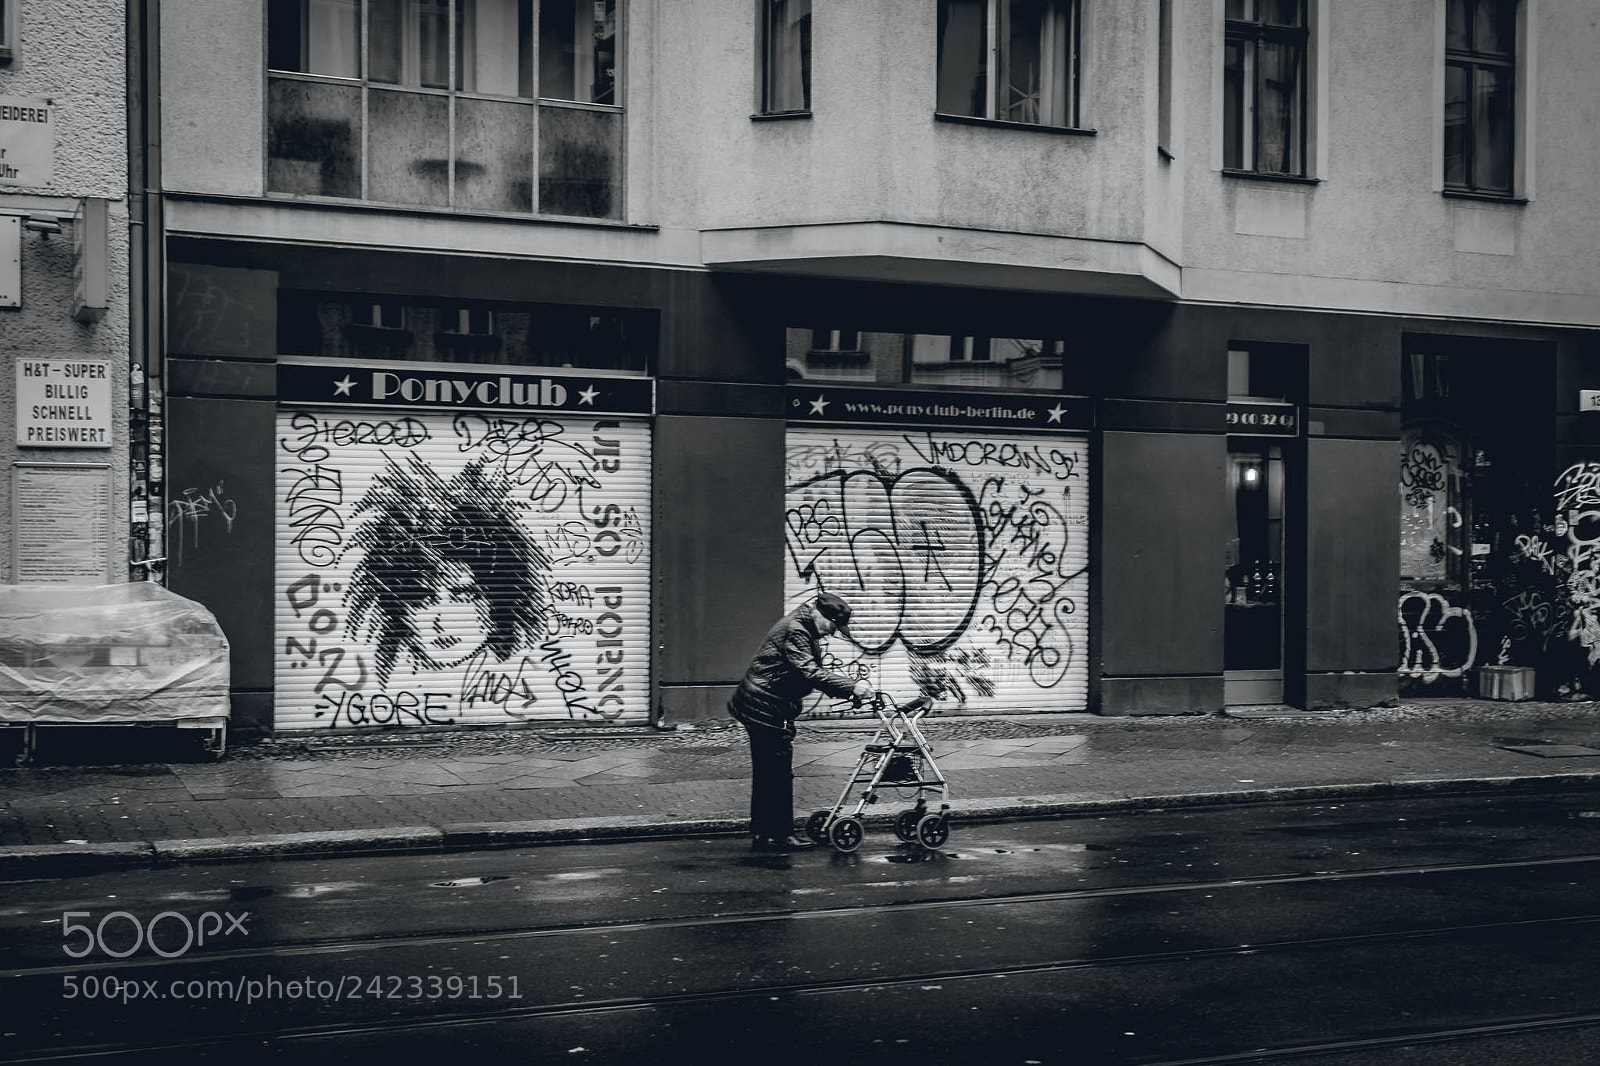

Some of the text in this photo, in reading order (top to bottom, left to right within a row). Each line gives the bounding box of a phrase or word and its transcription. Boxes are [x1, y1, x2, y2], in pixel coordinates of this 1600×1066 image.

[0, 106, 48, 124] EIDEREI
[24, 362, 50, 377] H&T
[64, 364, 106, 379] SUPER
[45, 384, 88, 399] BILLIG
[372, 372, 568, 407] Ponyclub
[32, 405, 92, 421] SCHNELL
[844, 402, 1036, 419] www.ponyclub-berlin.de
[1260, 413, 1277, 425] 32
[28, 427, 106, 442] PREISWERT
[595, 586, 625, 719] PORNO
